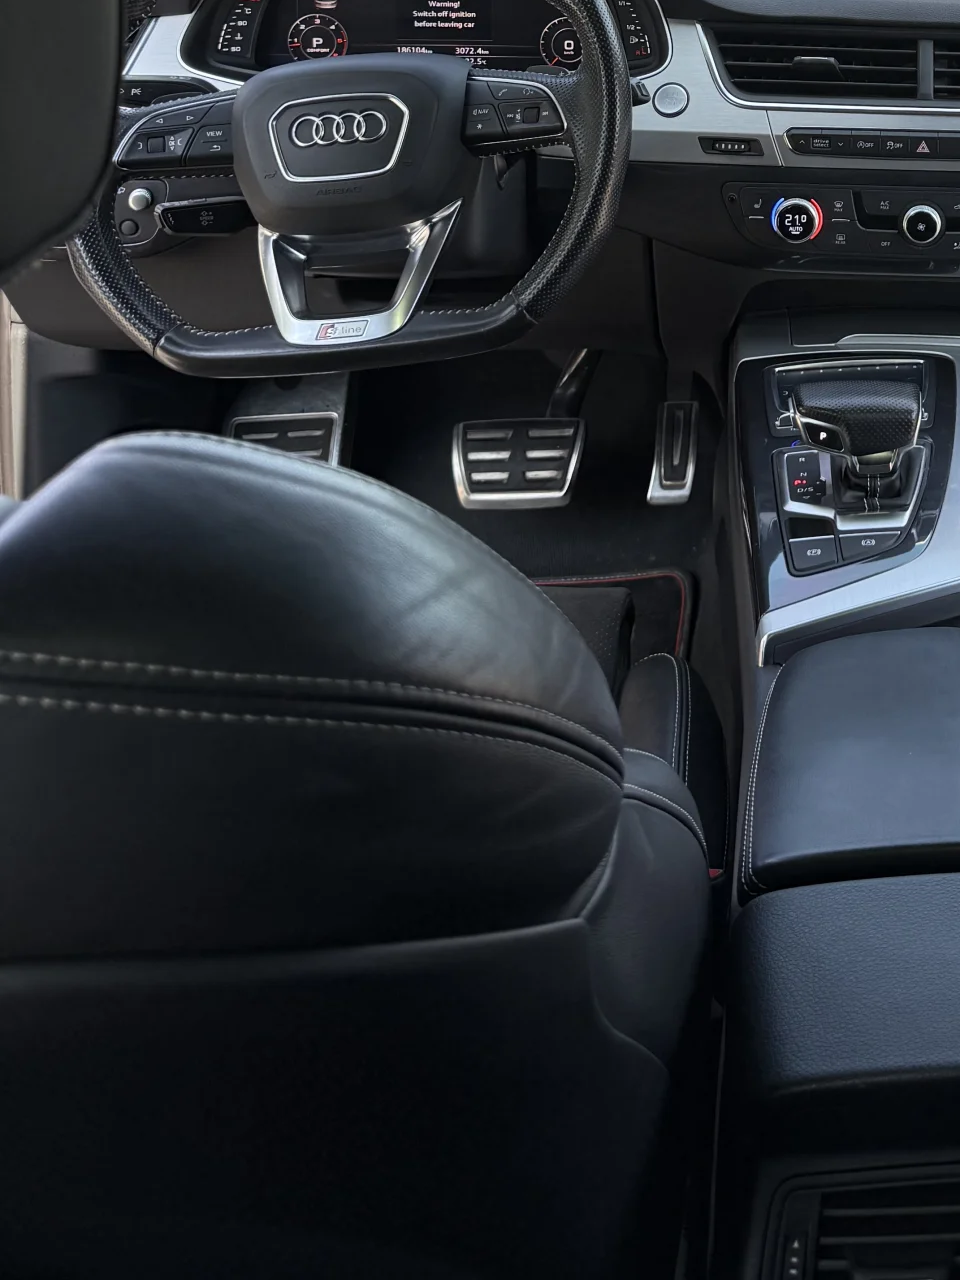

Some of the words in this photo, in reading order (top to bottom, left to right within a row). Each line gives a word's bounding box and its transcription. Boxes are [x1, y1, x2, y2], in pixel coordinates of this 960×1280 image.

[428, 0, 461, 8] Warning!
[449, 11, 477, 19] ignition
[438, 21, 463, 29] leaving
[312, 37, 324, 48] P
[564, 40, 574, 50] 0
[316, 186, 362, 196] AIRBAG
[341, 326, 362, 334] line
[820, 431, 827, 440] P
